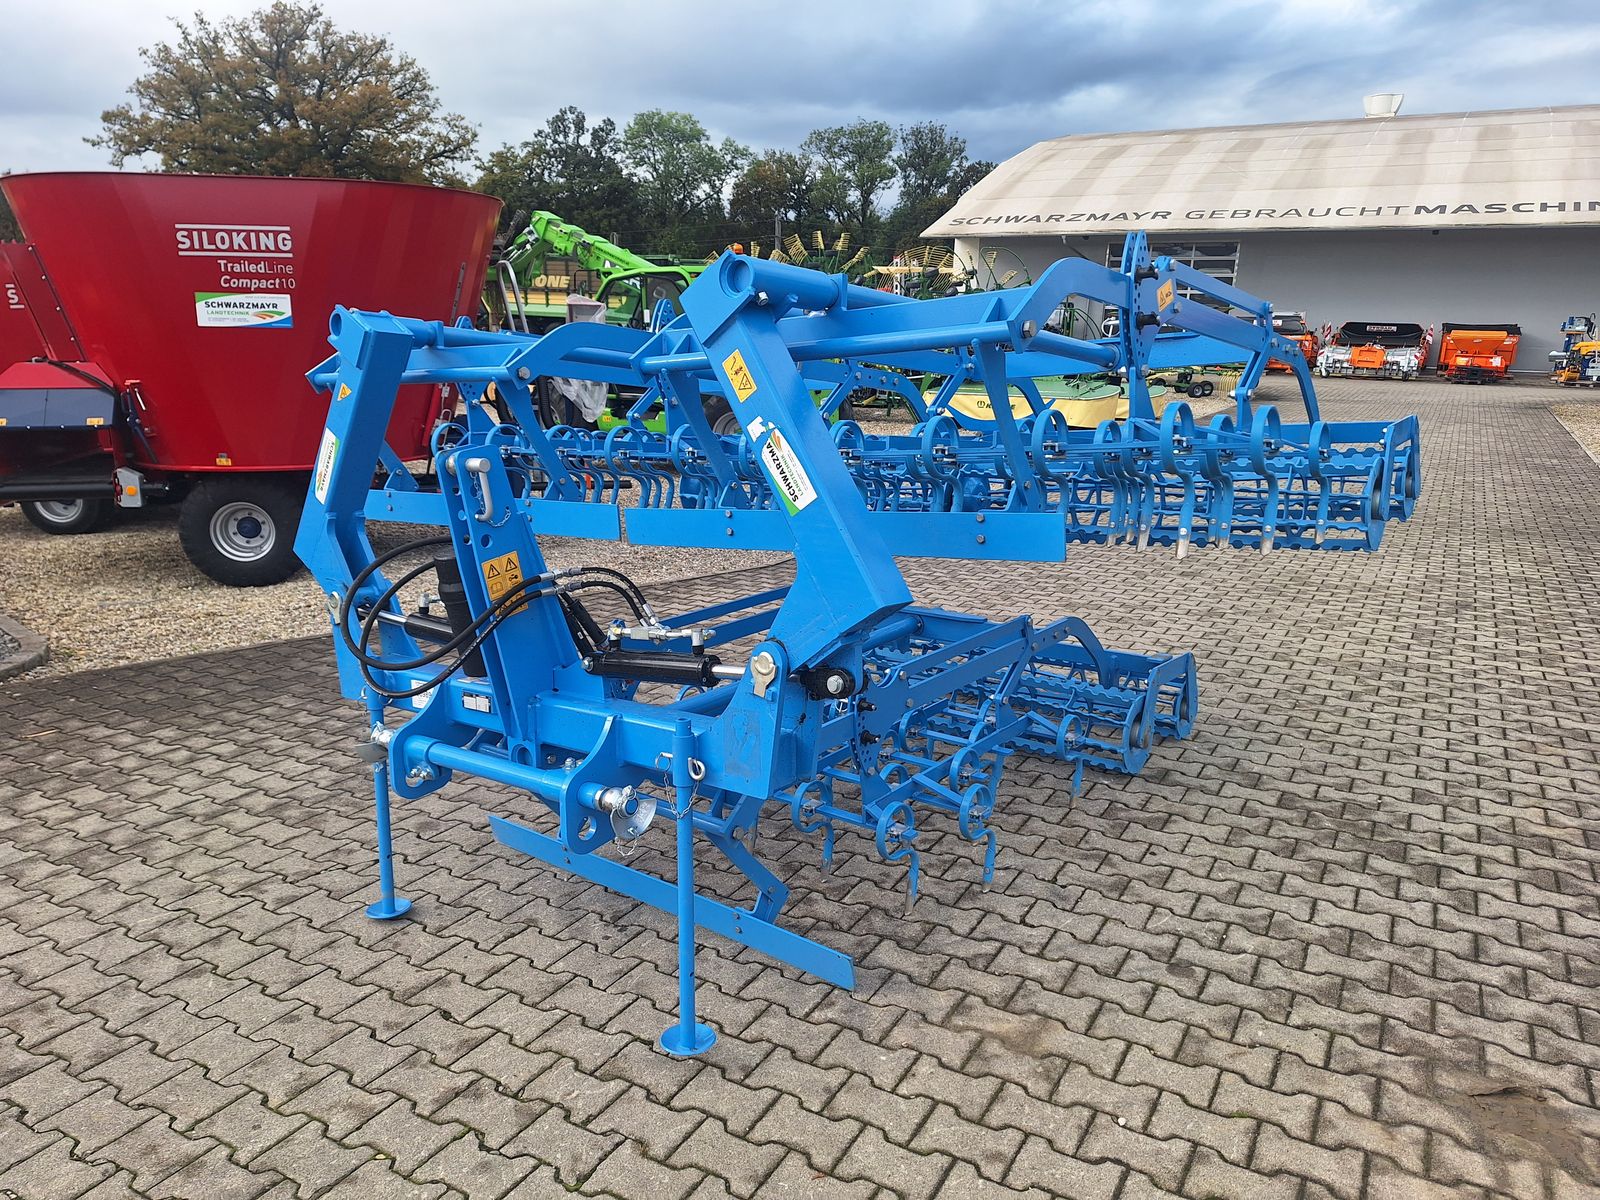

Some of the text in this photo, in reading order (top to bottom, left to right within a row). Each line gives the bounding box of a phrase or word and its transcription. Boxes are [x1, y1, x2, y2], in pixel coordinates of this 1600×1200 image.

[949, 210, 1172, 226] SCHWARZMAYR
[175, 230, 292, 251] SILOKING
[217, 259, 294, 274] TrailedLine
[532, 274, 571, 288] ONE
[204, 301, 278, 310] SCHWARZMAYR
[781, 454, 804, 496] LANDTECHNIK
